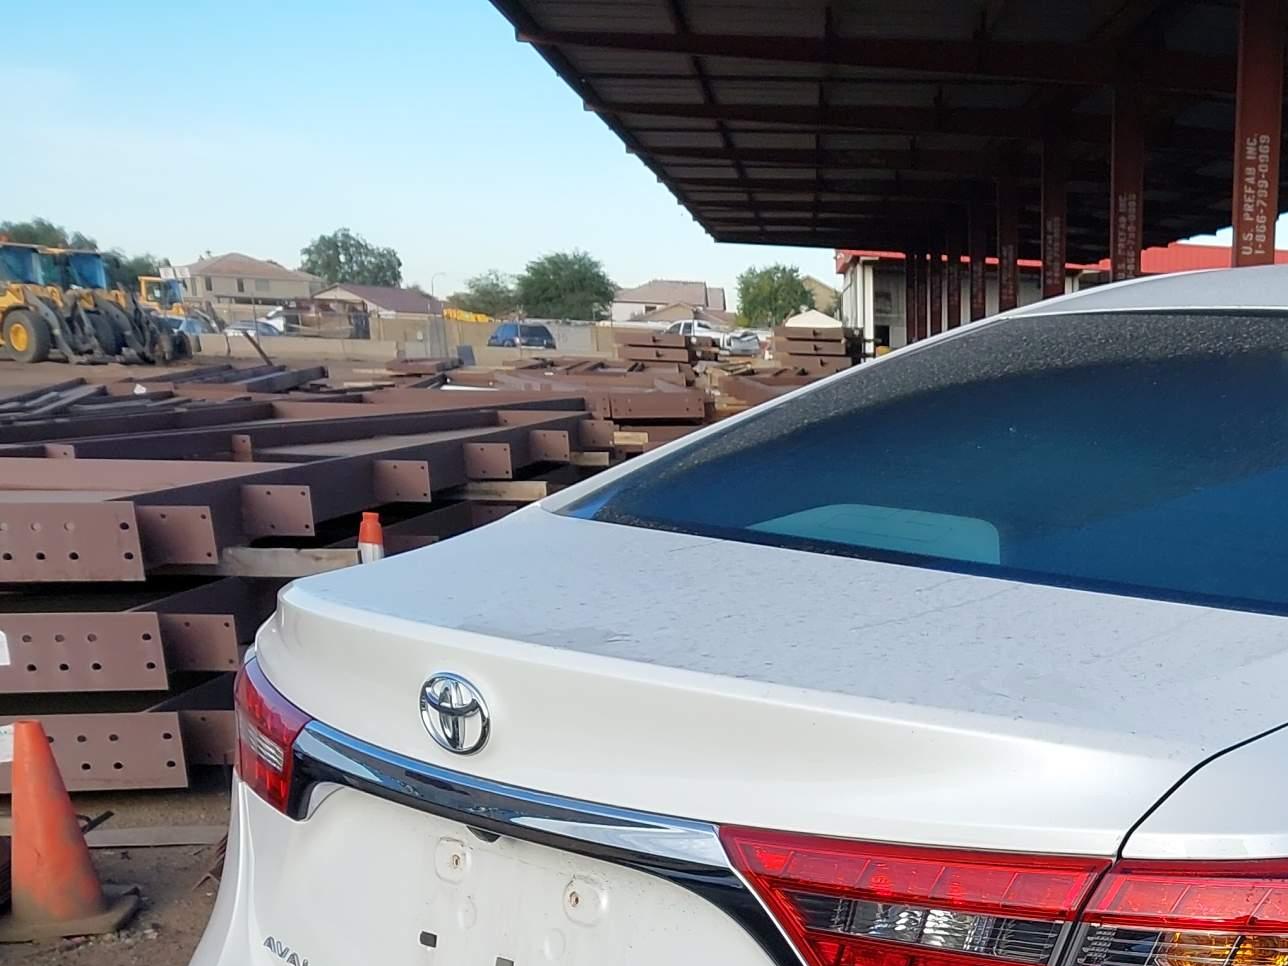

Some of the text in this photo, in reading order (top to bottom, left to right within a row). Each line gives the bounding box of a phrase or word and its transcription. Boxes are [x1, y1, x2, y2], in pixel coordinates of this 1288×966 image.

[1241, 133, 1258, 256] U.S. PREFAB INC.
